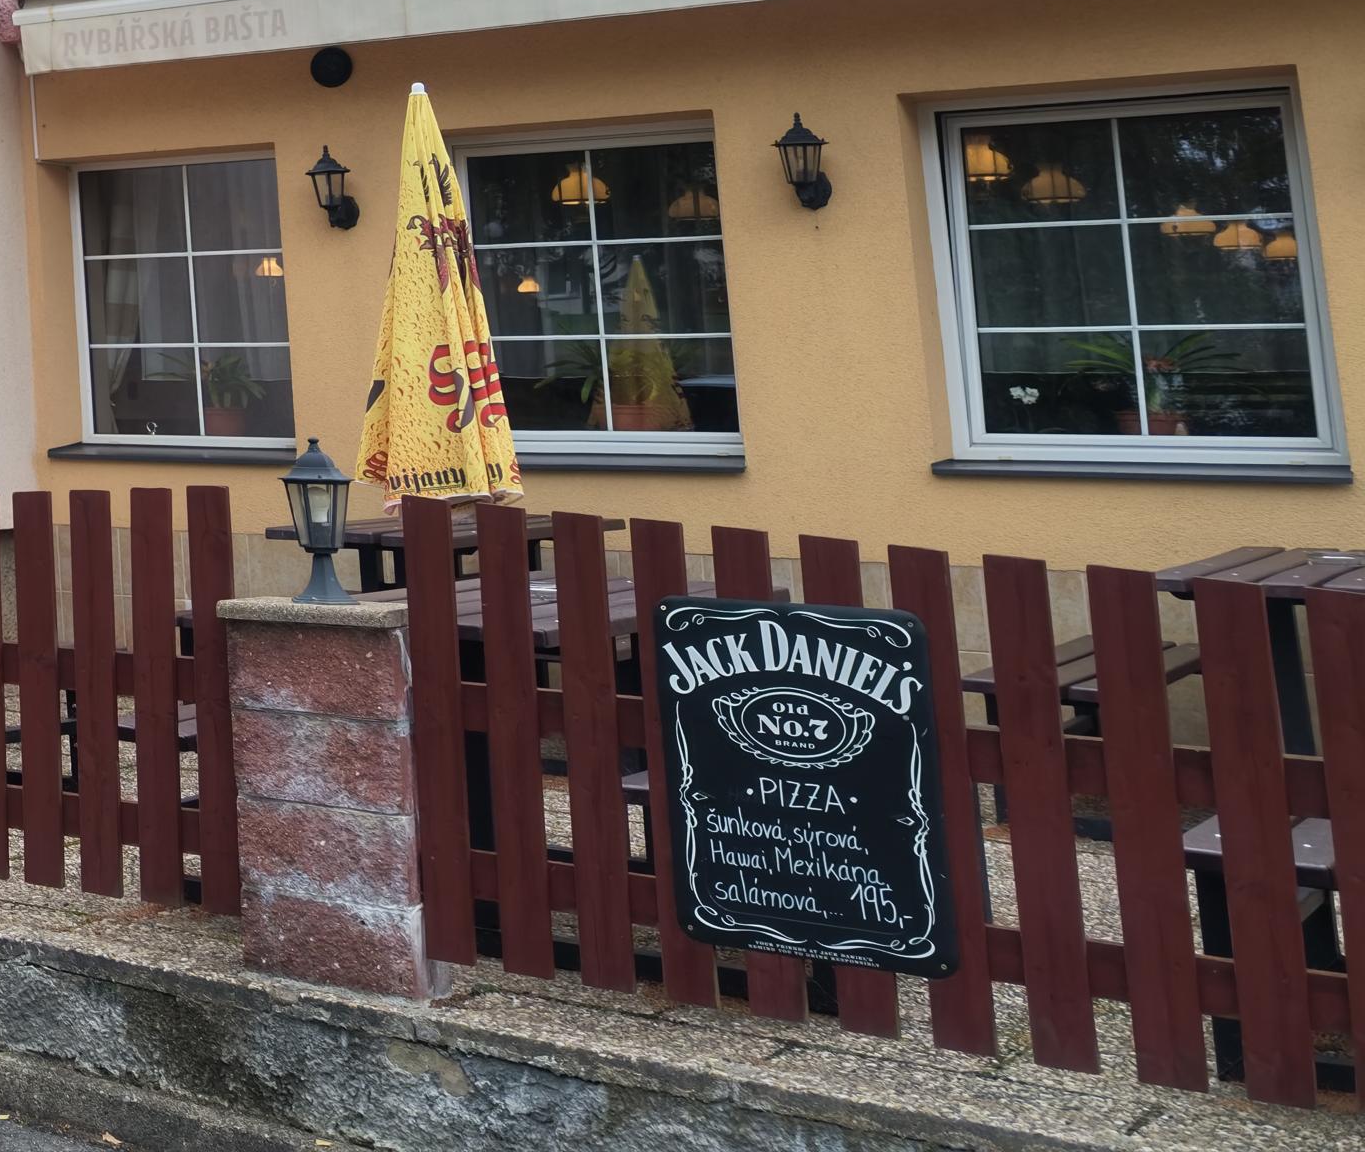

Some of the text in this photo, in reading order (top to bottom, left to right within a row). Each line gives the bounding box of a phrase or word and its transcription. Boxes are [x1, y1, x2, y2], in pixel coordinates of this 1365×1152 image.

[63, 5, 287, 57] RYBÁŘSKÁ BAŠTA
[663, 620, 924, 715] JACK DANIEL'S
[772, 702, 809, 715] Old
[757, 714, 829, 740] No.7
[775, 740, 815, 750] BRAND
[759, 777, 845, 815] PIZZA
